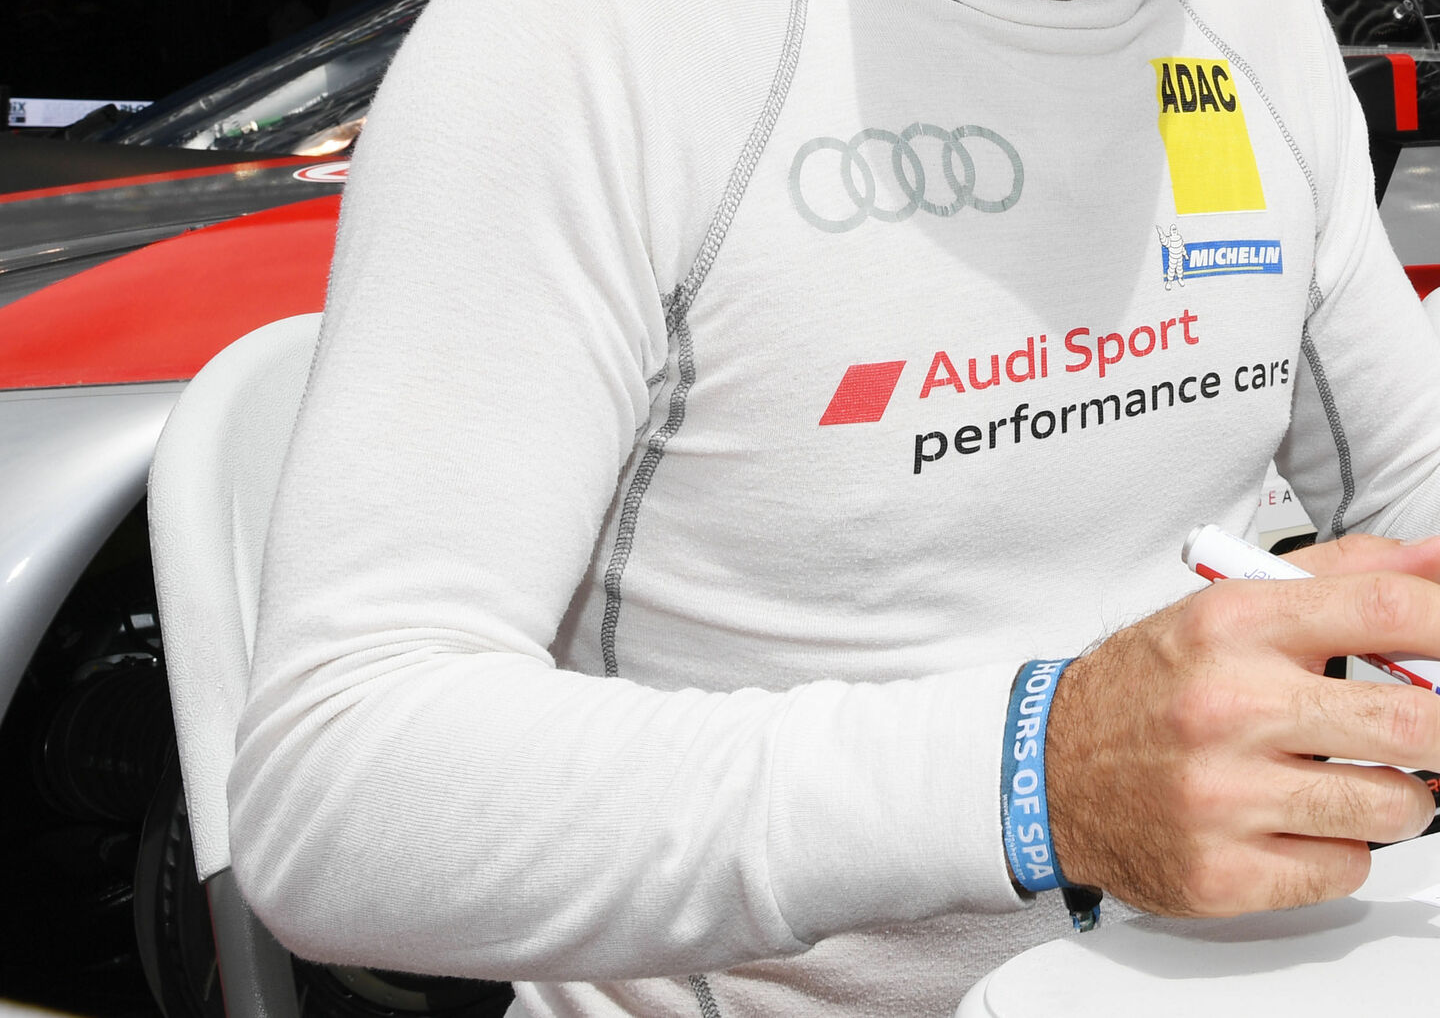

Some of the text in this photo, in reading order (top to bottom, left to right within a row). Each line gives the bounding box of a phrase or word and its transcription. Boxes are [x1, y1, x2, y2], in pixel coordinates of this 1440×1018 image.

[1160, 62, 1238, 114] ADAC
[1189, 245, 1282, 269] MICHELIN
[919, 308, 1200, 399] Audi Sport
[913, 356, 1291, 475] performance cars
[1012, 660, 1060, 880] HOURS OF SPA
